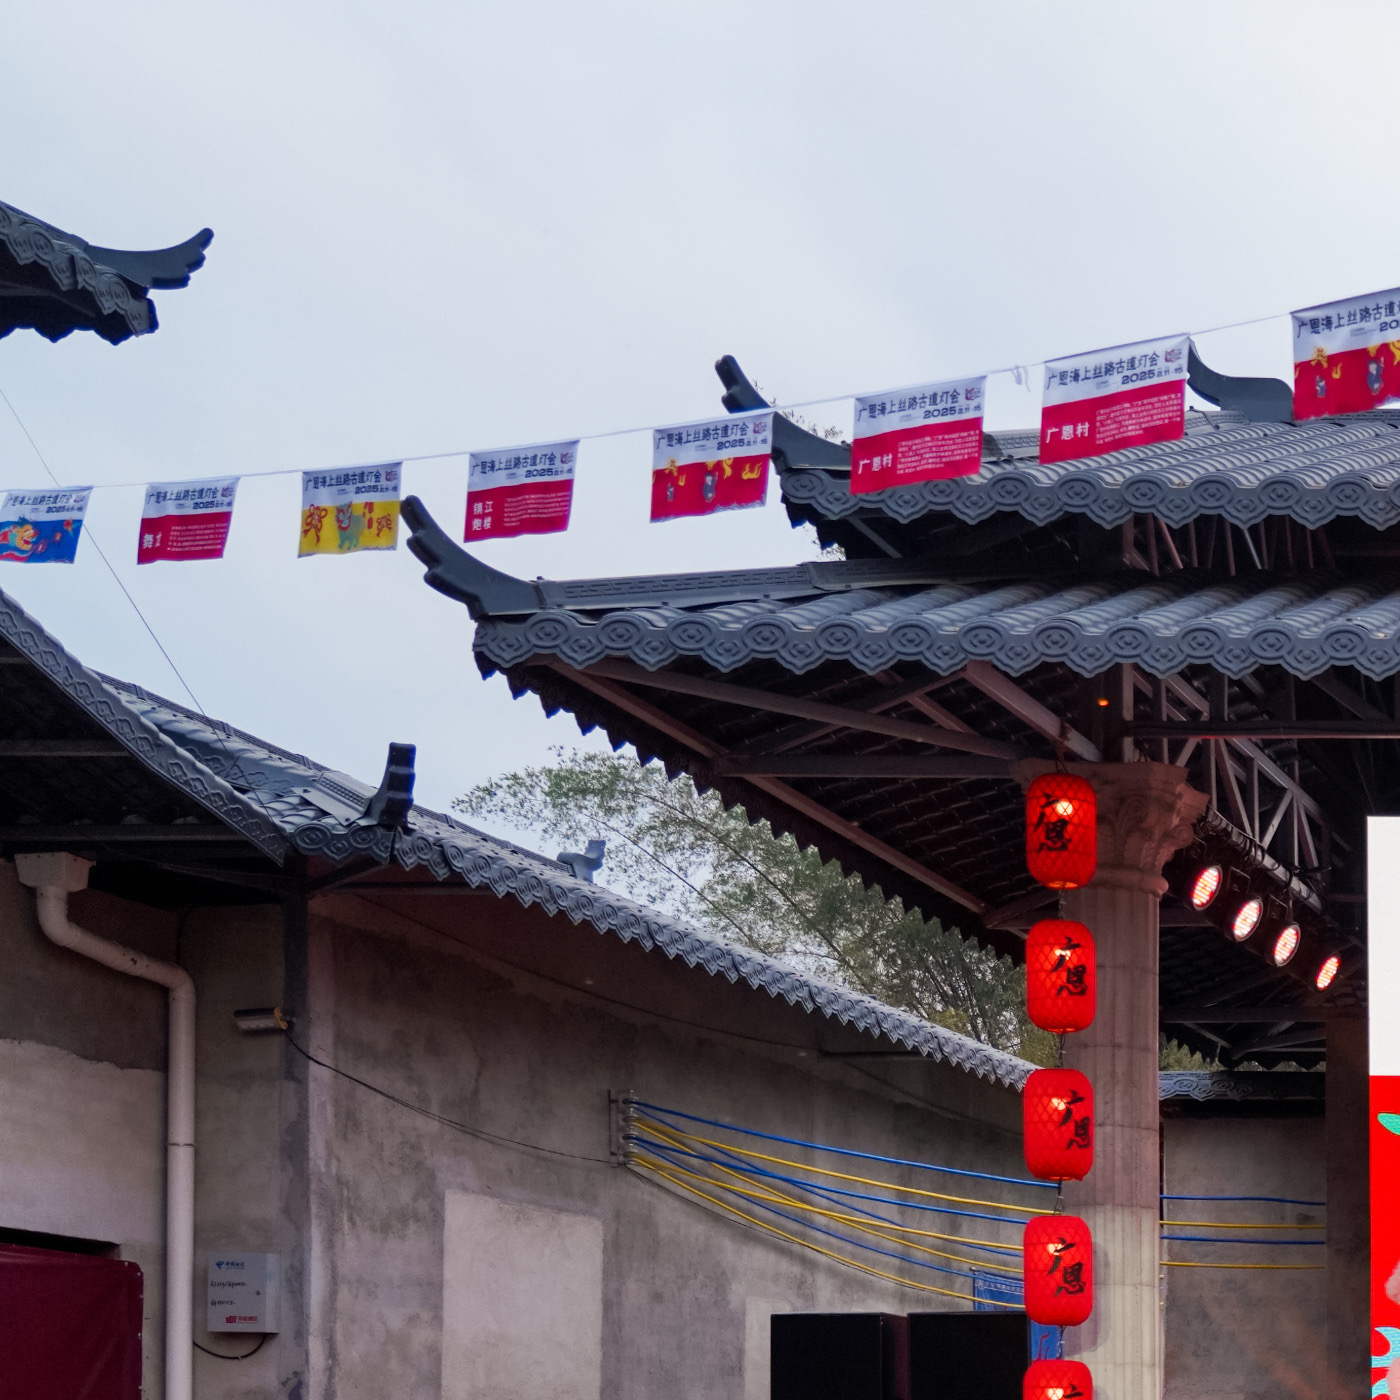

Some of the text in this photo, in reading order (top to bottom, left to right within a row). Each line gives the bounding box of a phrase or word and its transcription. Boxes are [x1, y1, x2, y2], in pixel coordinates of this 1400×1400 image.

[1047, 351, 1160, 390] 广恩海上丝路古道灯会
[1121, 369, 1156, 385] 2025
[923, 406, 956, 419] 2025
[1046, 422, 1090, 443] 广恩村
[717, 438, 745, 450] 2025
[858, 453, 893, 474] 广恩村
[525, 468, 554, 478] 2025
